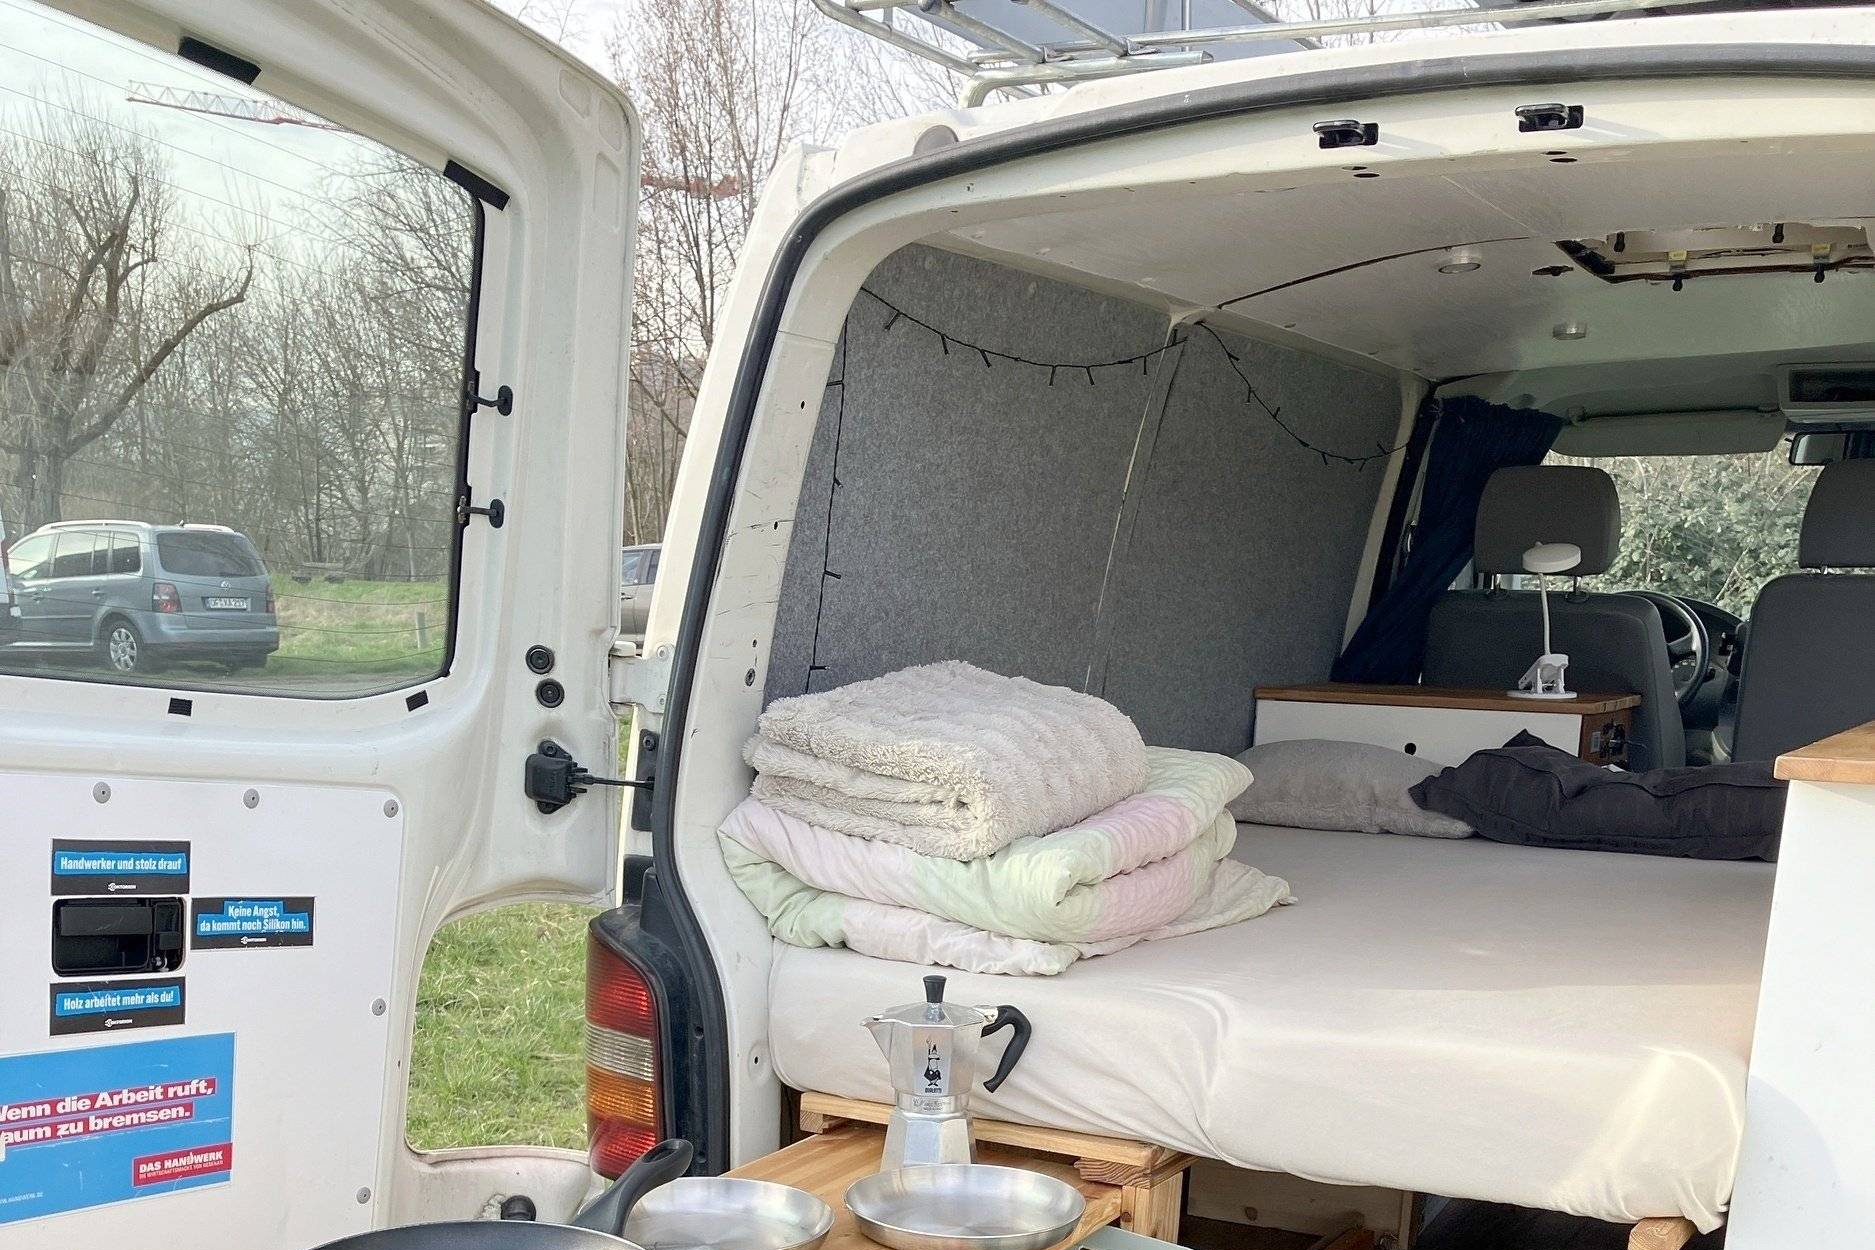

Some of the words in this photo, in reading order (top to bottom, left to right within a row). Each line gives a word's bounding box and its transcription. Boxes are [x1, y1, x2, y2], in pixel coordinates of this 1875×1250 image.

[61, 857, 116, 870] Handwerker
[117, 858, 134, 870] und
[135, 857, 157, 870] stolz
[158, 857, 182, 870] drauf
[228, 905, 252, 918] Keine
[253, 906, 280, 918] Angst,
[200, 920, 211, 932] da
[212, 919, 241, 931] kommt
[242, 919, 262, 930] noch
[263, 918, 290, 930] Silikon
[291, 918, 306, 930] hin.
[64, 998, 85, 1010] Holz
[85, 994, 120, 1009] arbeitet
[122, 994, 145, 1006] mehr
[145, 993, 159, 1004] als
[160, 990, 174, 1003] du!
[56, 1096, 92, 1114] die
[94, 1085, 164, 1109] Arbeit
[167, 1079, 214, 1099] ruft,
[56, 1120, 84, 1137] zu
[89, 1105, 191, 1132] bremsen.
[139, 1161, 162, 1174] DAS
[163, 1151, 224, 1169] HANDWERK
